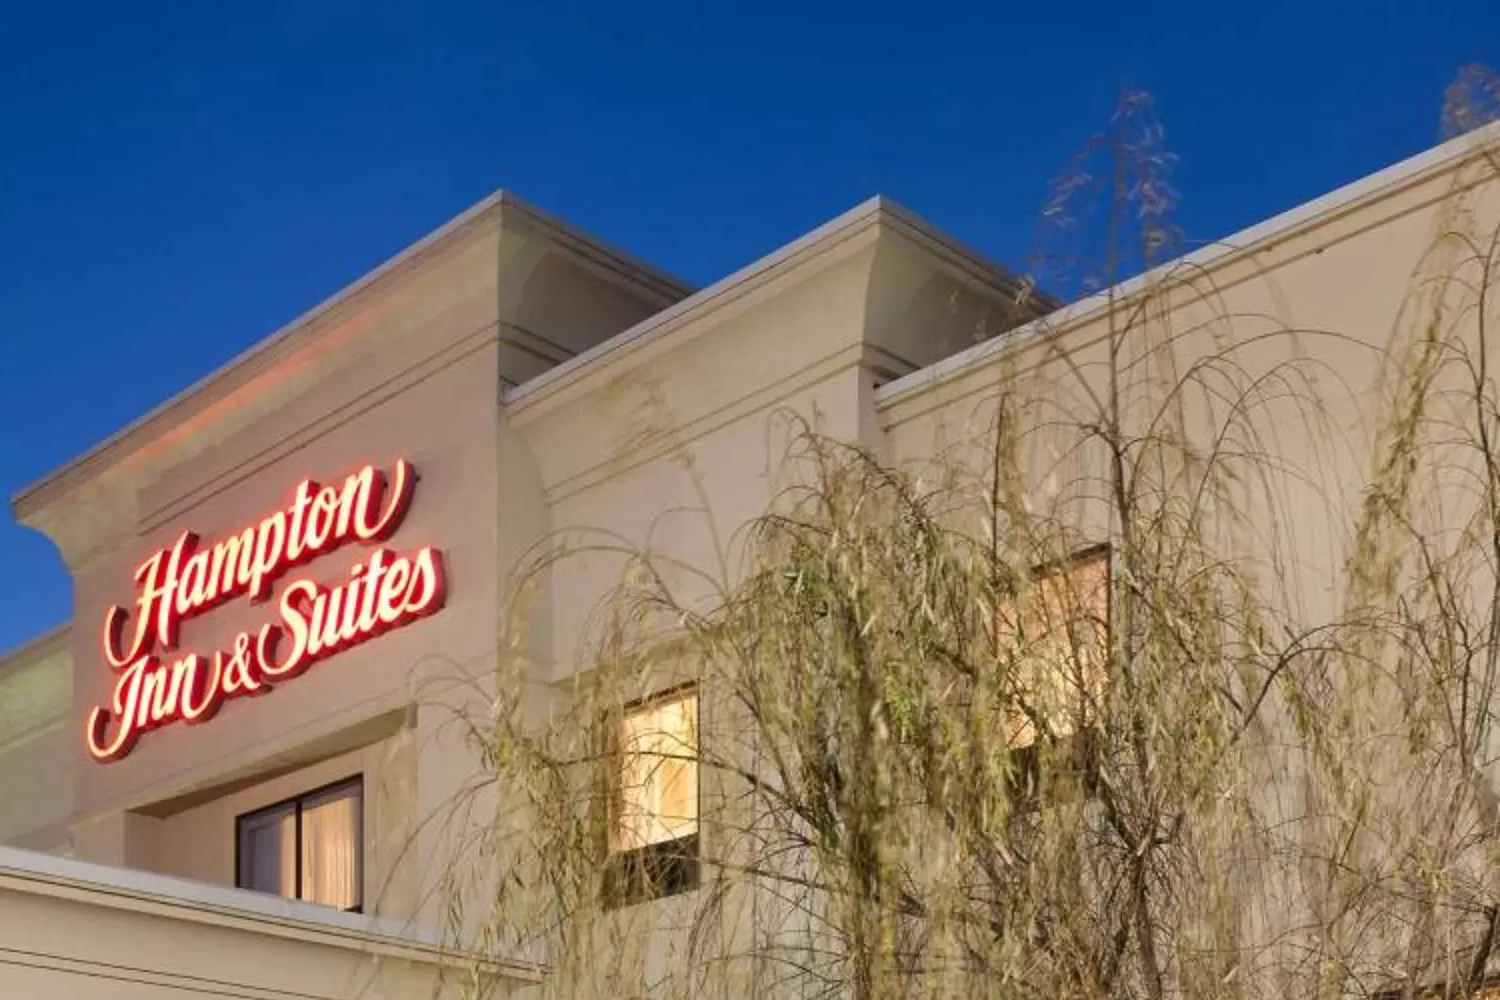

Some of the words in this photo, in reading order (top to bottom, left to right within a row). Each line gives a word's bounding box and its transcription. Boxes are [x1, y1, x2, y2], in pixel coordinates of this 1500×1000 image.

[85, 650, 224, 761] Inn
[223, 631, 264, 693] &
[256, 546, 443, 678] Suites
[102, 457, 414, 668] Hampton
